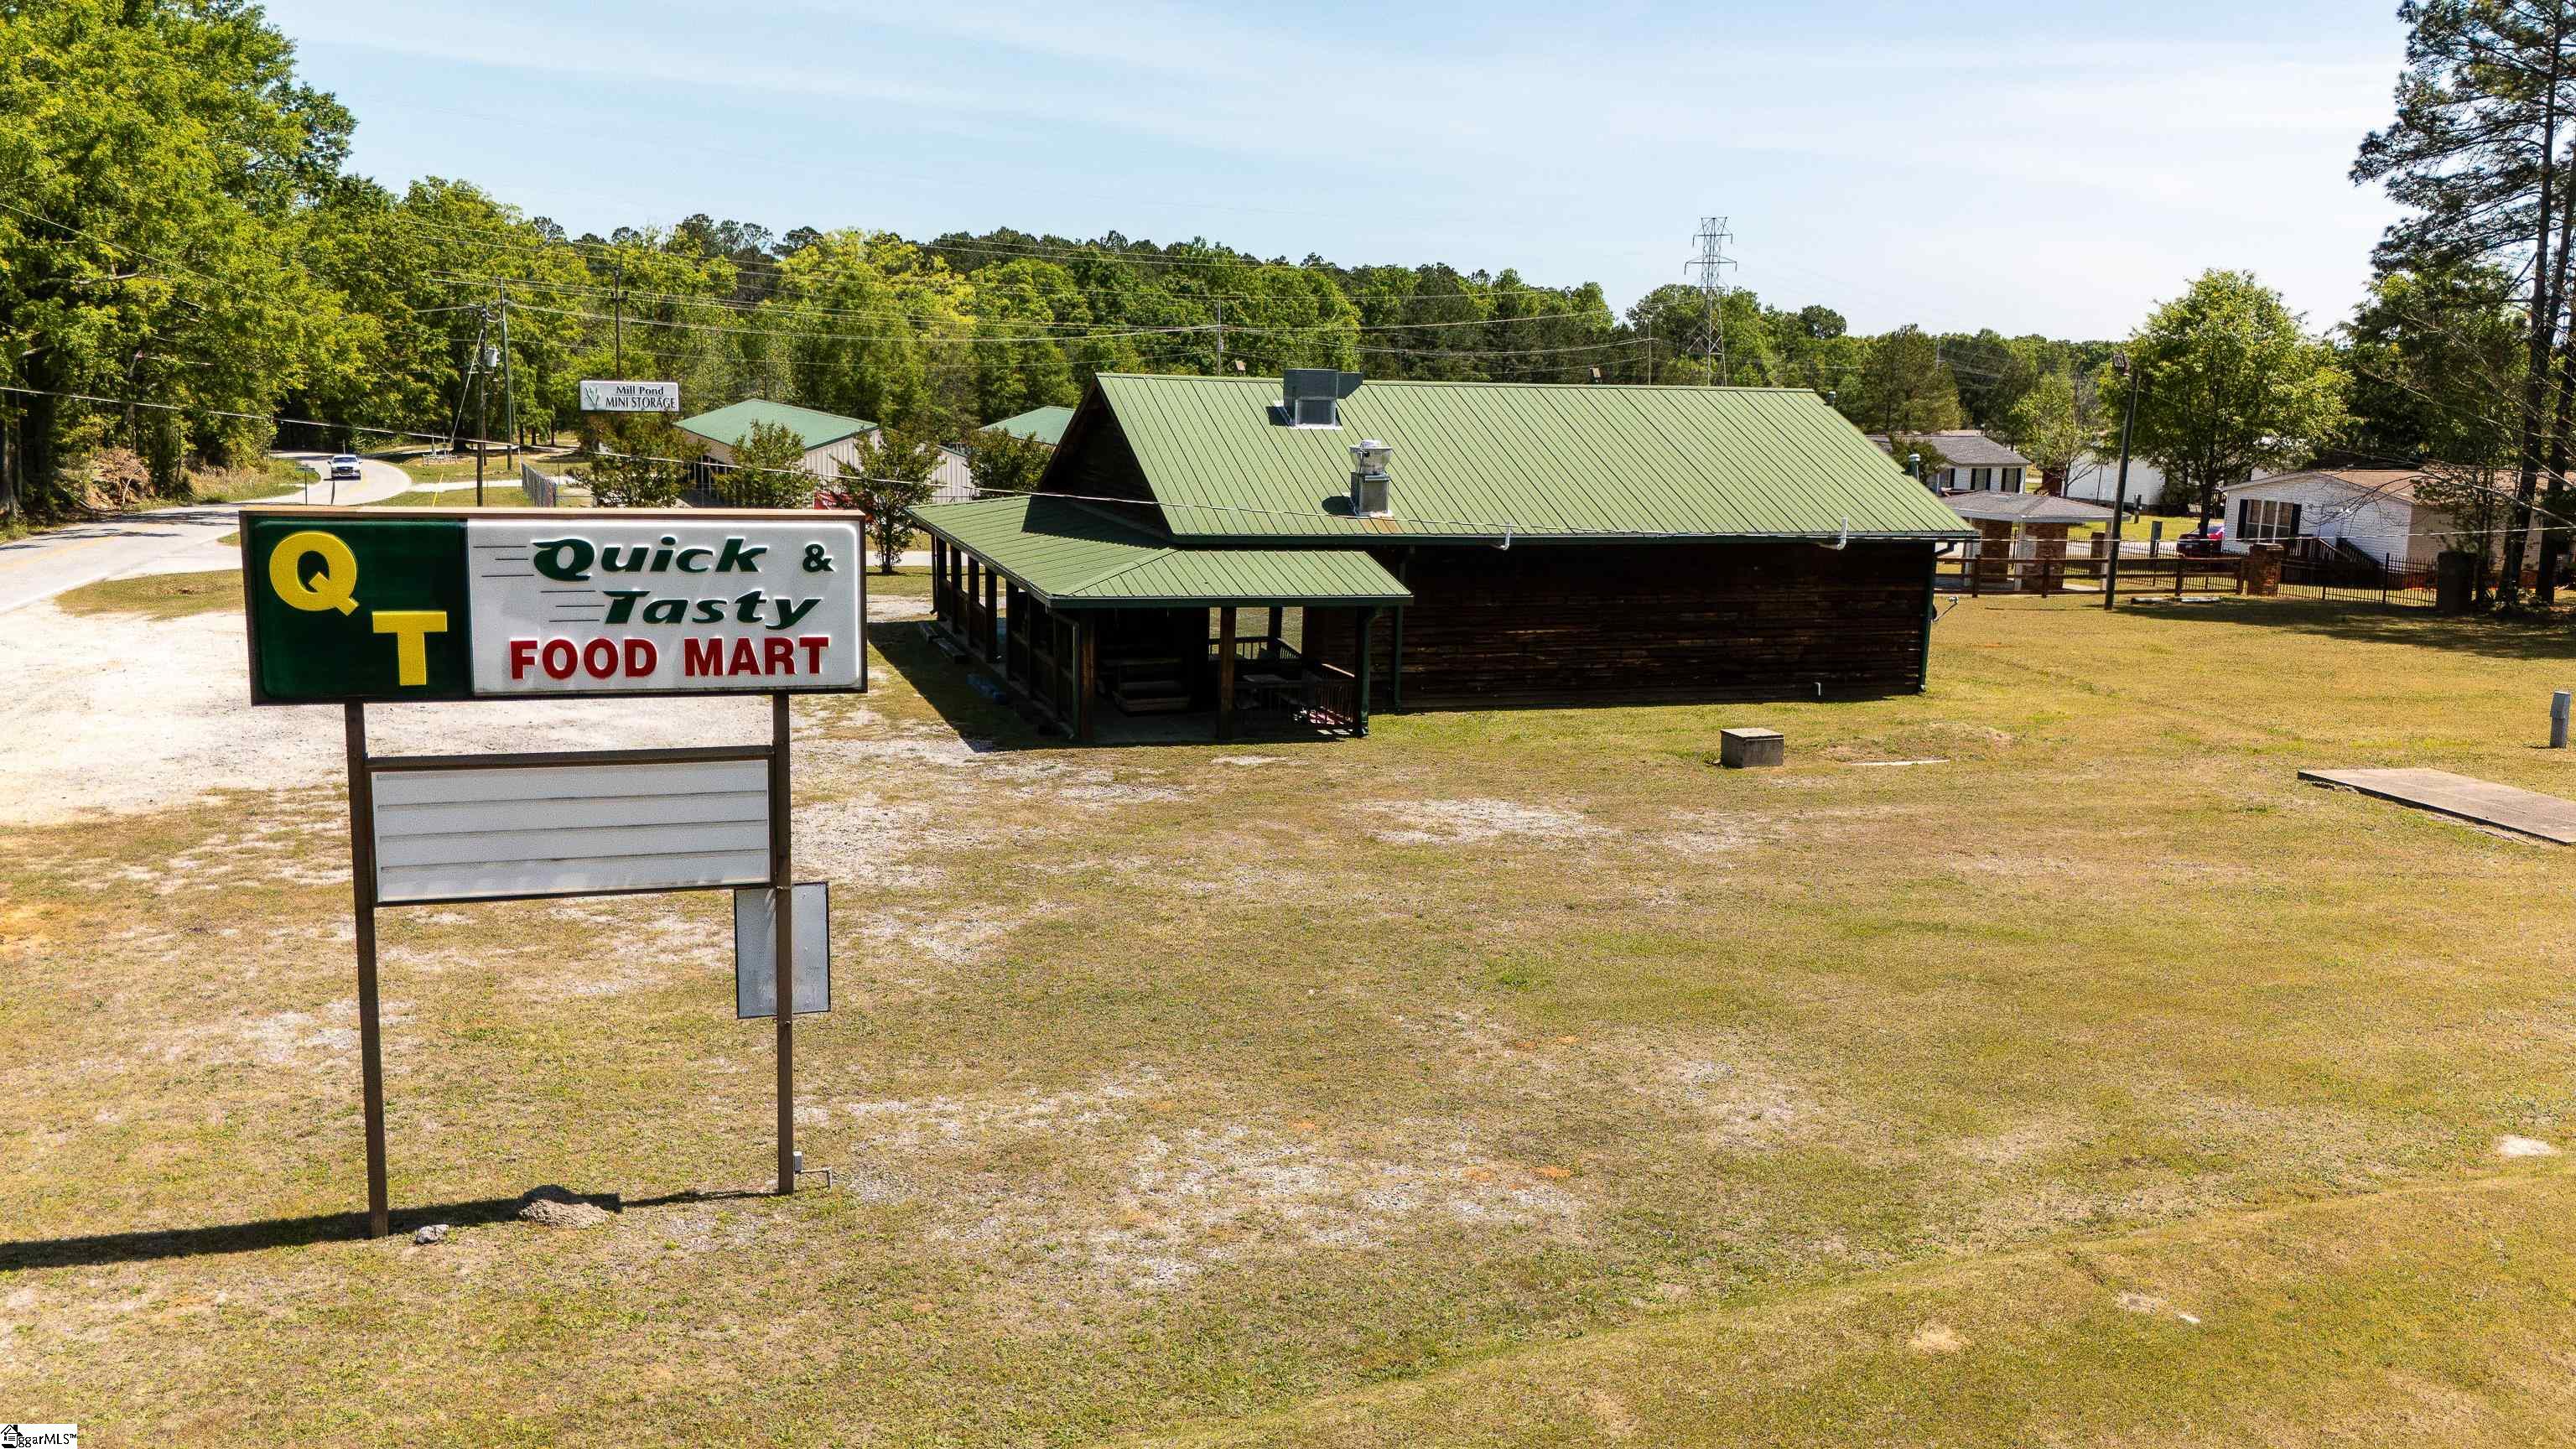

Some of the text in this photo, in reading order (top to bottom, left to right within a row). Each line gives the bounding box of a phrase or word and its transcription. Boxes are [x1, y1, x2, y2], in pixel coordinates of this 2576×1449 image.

[605, 397, 676, 408] MINI STORAGE
[616, 386, 664, 395] Mill Pond
[269, 531, 359, 615] Q
[532, 537, 835, 582] Quick &
[601, 589, 823, 631] Tasty
[371, 610, 448, 686] T
[509, 636, 830, 680] FOOD MART
